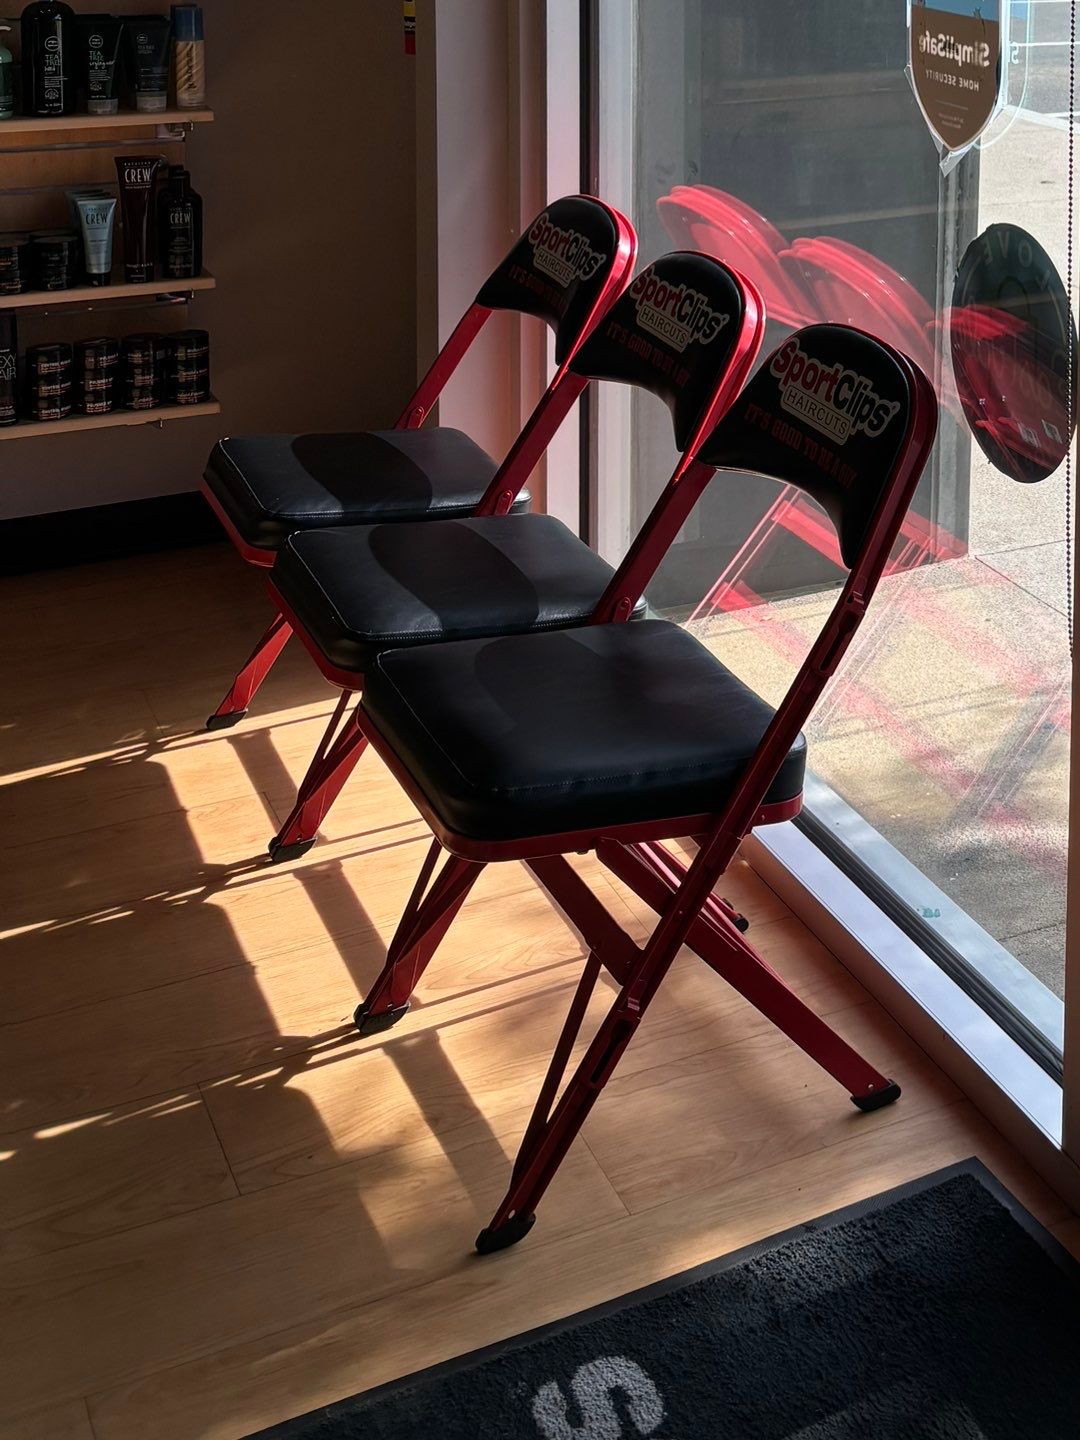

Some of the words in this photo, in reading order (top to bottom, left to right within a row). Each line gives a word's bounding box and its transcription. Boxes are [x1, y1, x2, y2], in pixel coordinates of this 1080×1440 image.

[124, 169, 152, 183] CREW
[85, 213, 108, 225] CREW
[170, 212, 191, 225] CREW
[530, 214, 604, 279] SportClips
[631, 265, 727, 342] SportClips
[641, 308, 688, 344] HAIRCUTS
[771, 339, 897, 434] SportClips
[787, 388, 849, 436] HAIRCUTS
